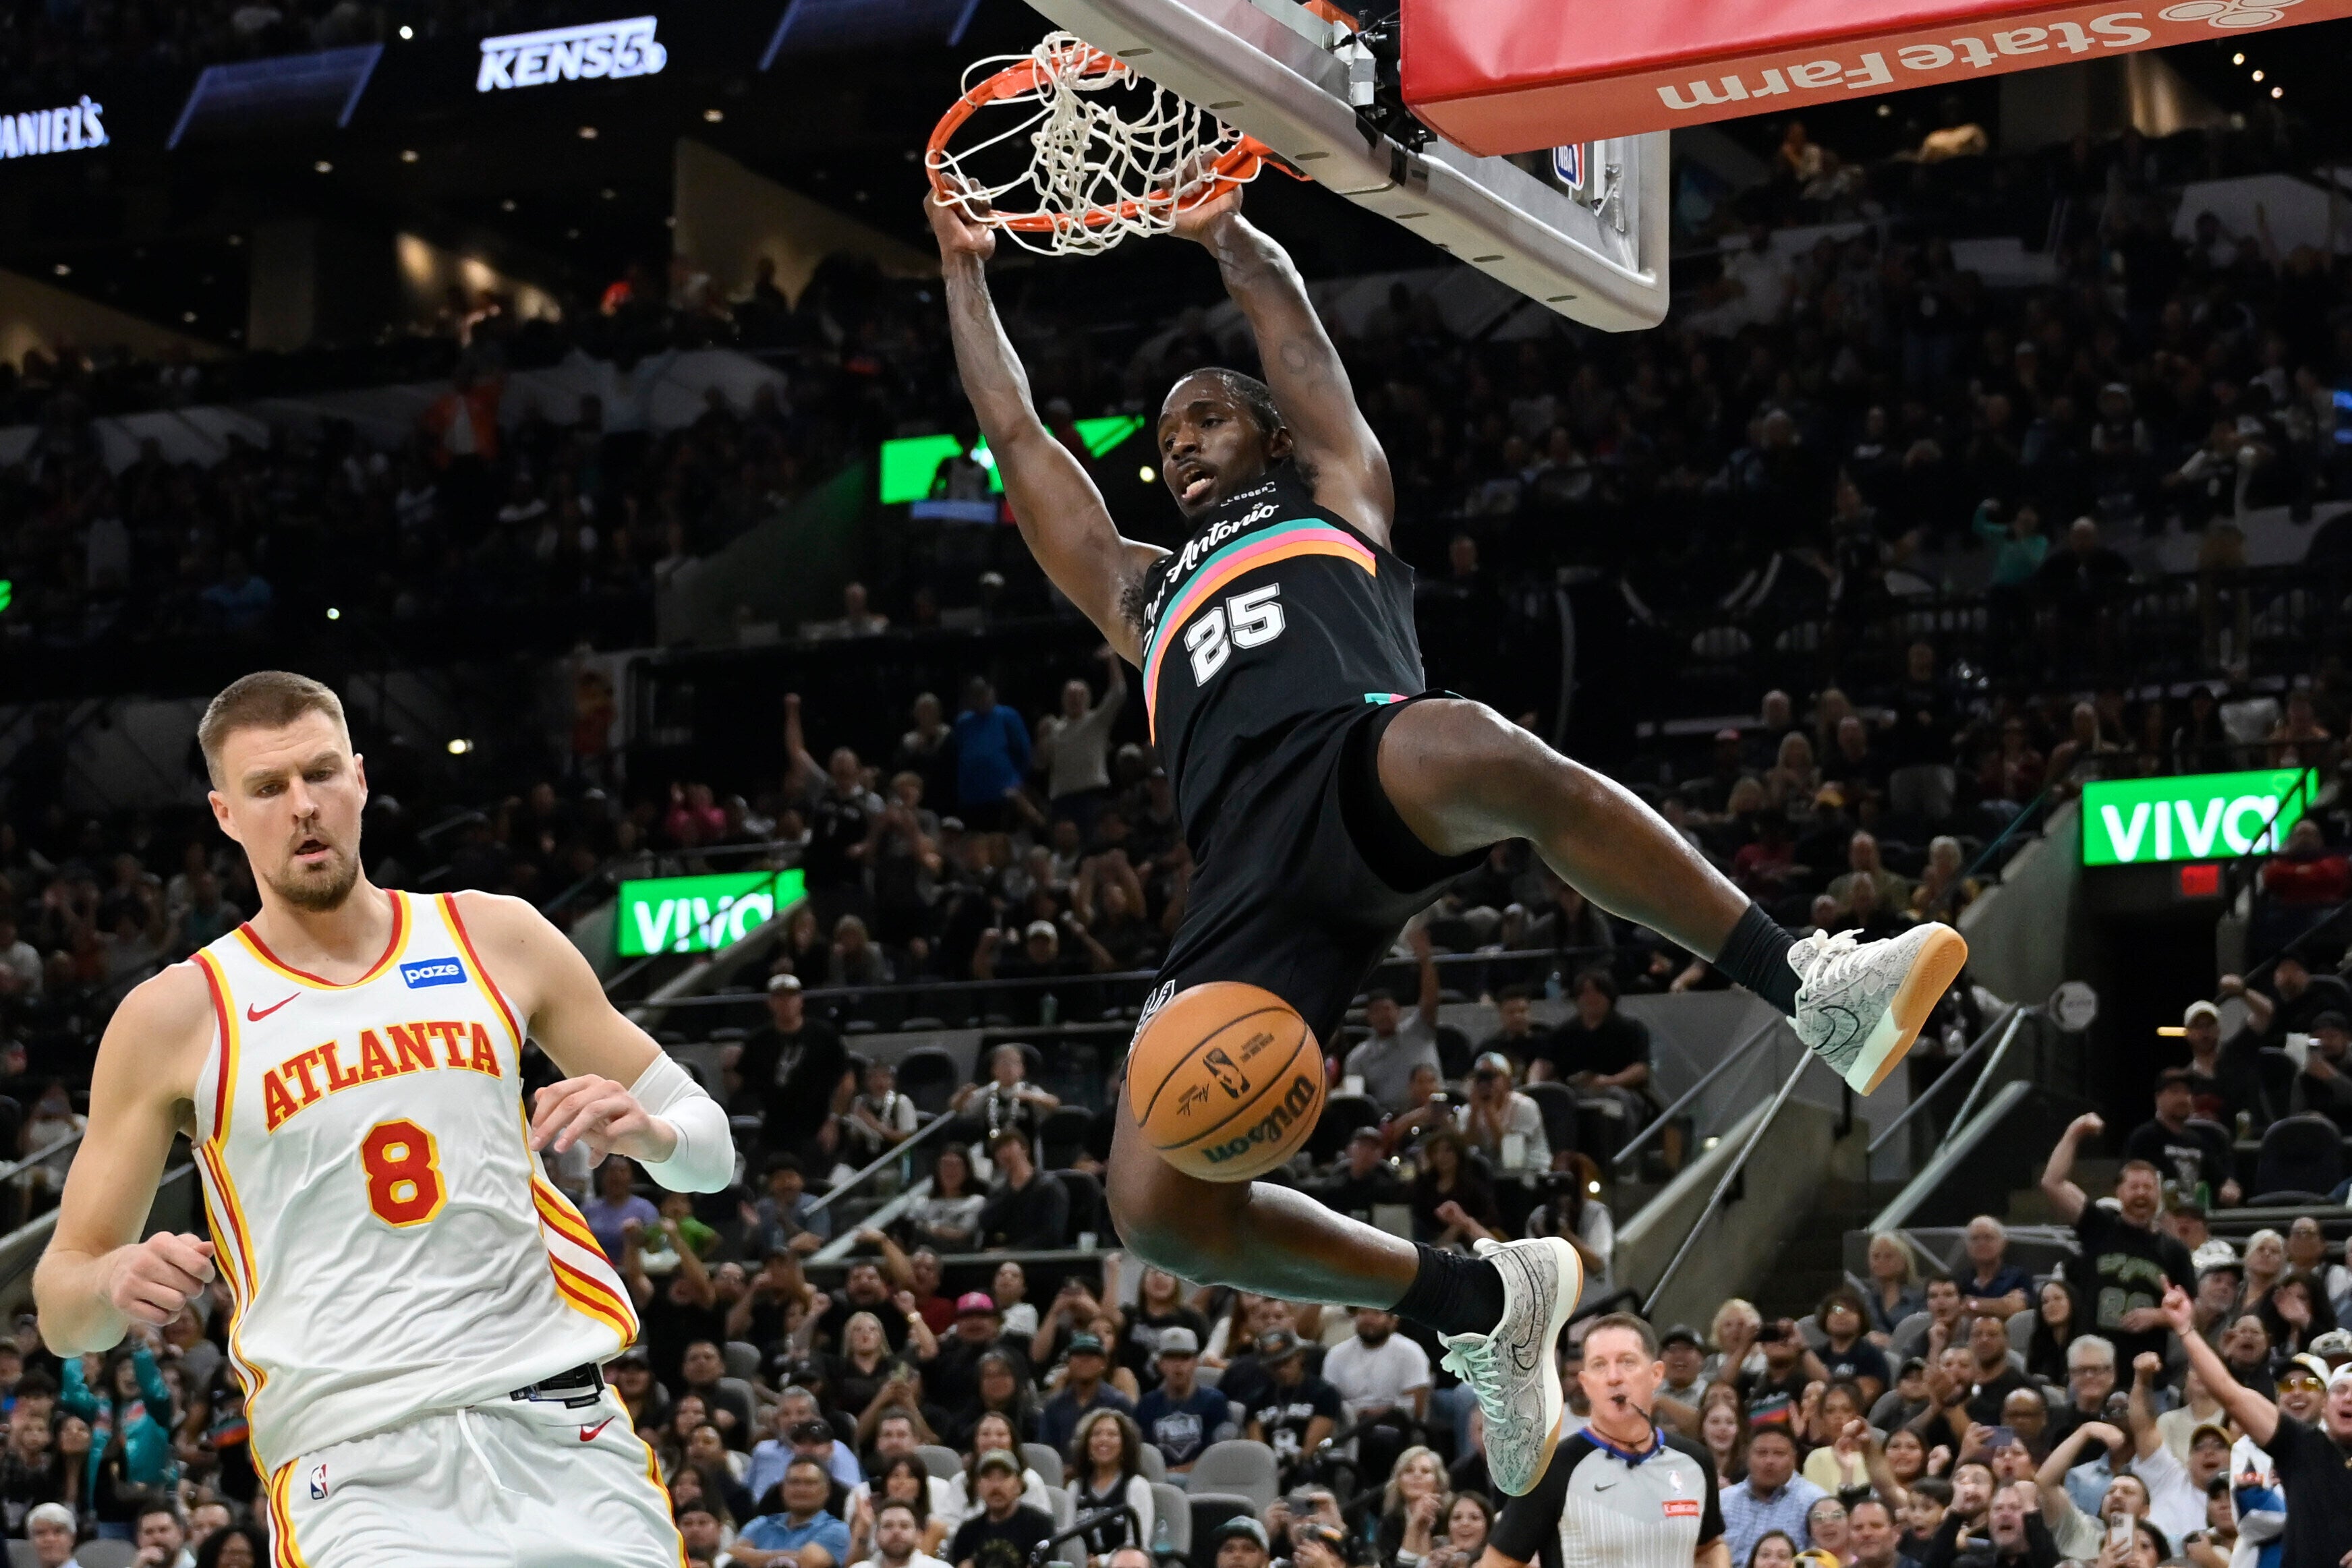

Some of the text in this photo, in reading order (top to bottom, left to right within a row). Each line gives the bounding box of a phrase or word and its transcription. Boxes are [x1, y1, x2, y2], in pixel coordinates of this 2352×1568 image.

[0, 94, 105, 159] ANIEL'S
[1166, 503, 1280, 583] Antonio
[1184, 582, 1286, 687] 25
[405, 964, 459, 984] paze
[262, 1020, 503, 1136] ATLANTA
[360, 1117, 449, 1229] 8
